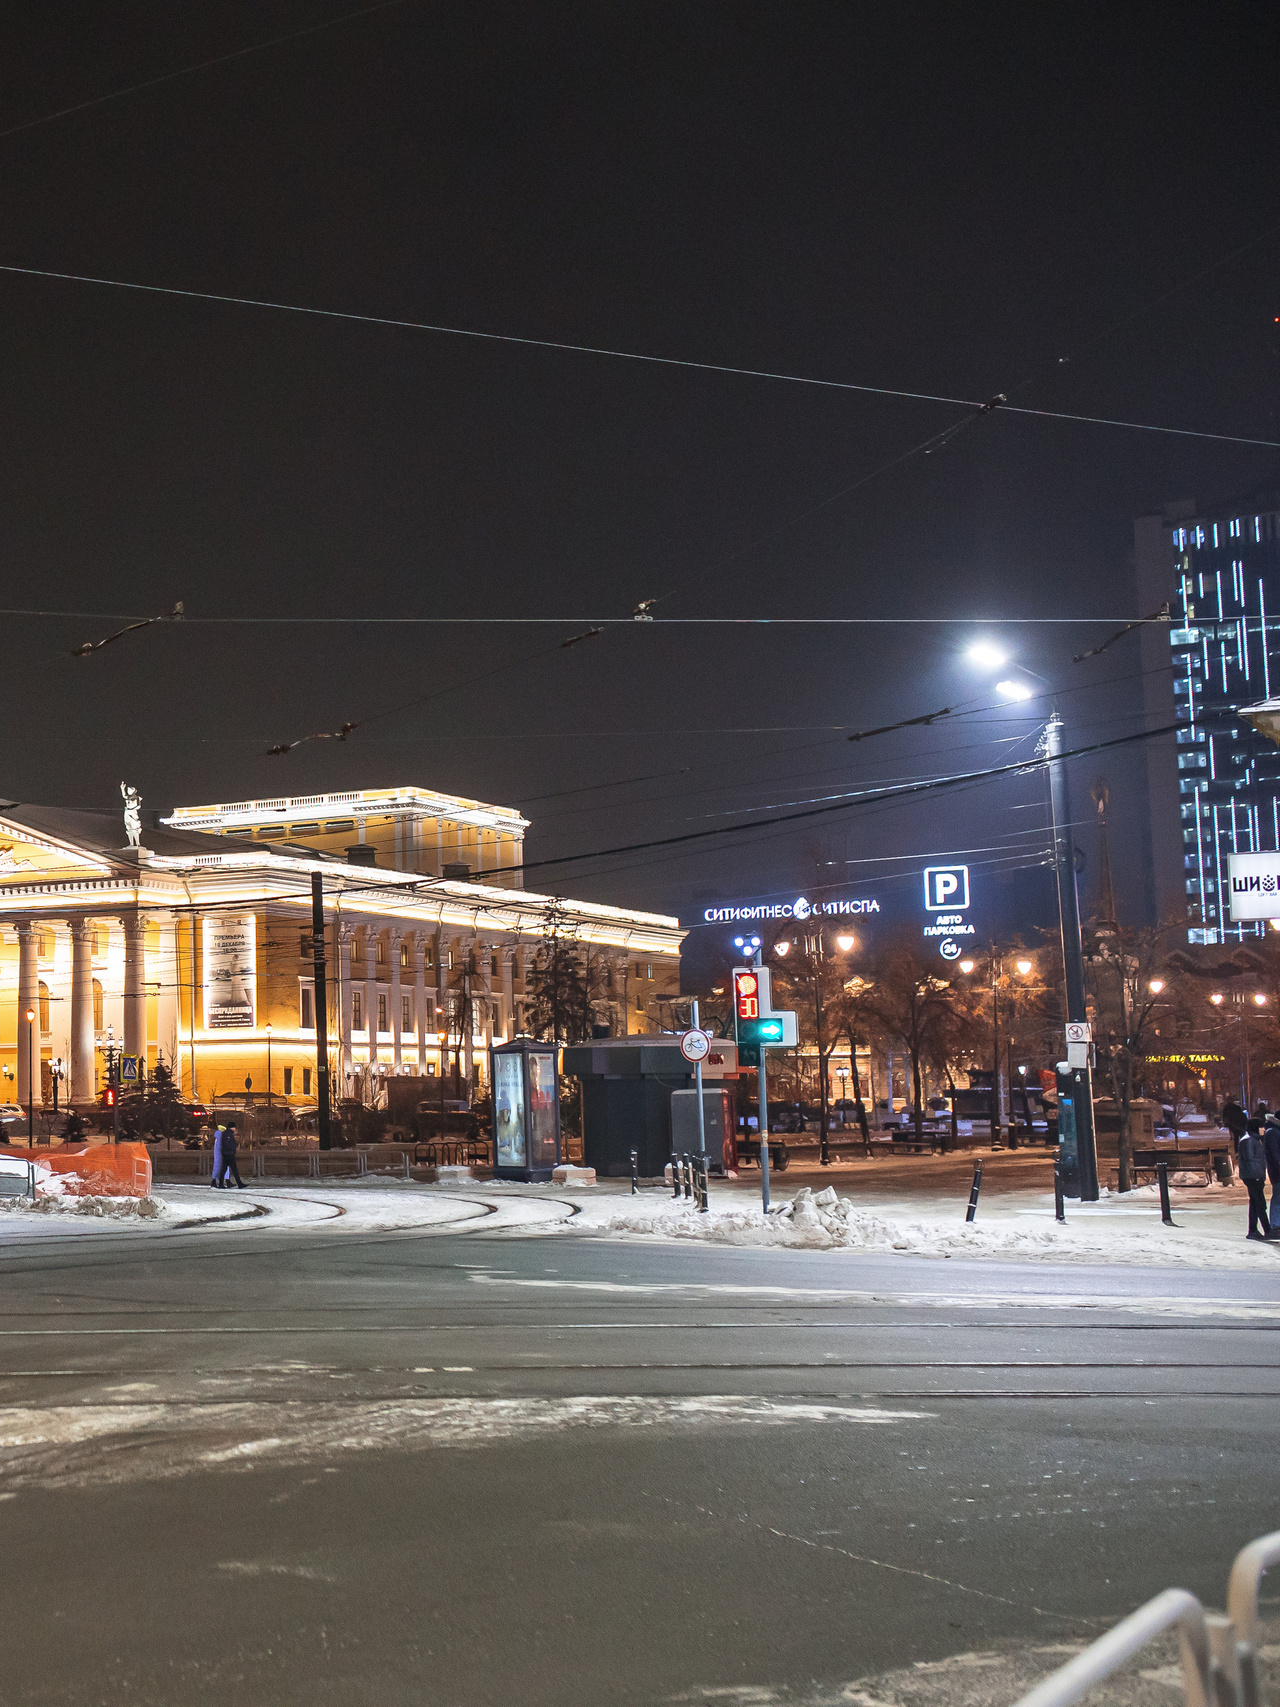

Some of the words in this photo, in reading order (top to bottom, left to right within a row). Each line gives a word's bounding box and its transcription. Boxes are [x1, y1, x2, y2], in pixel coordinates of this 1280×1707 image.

[935, 873, 958, 904] P
[704, 905, 792, 921] СИТИФИТНЕС
[936, 915, 962, 925] АВТО
[923, 925, 975, 936] ПАРКОВКА
[944, 944, 957, 953] 24
